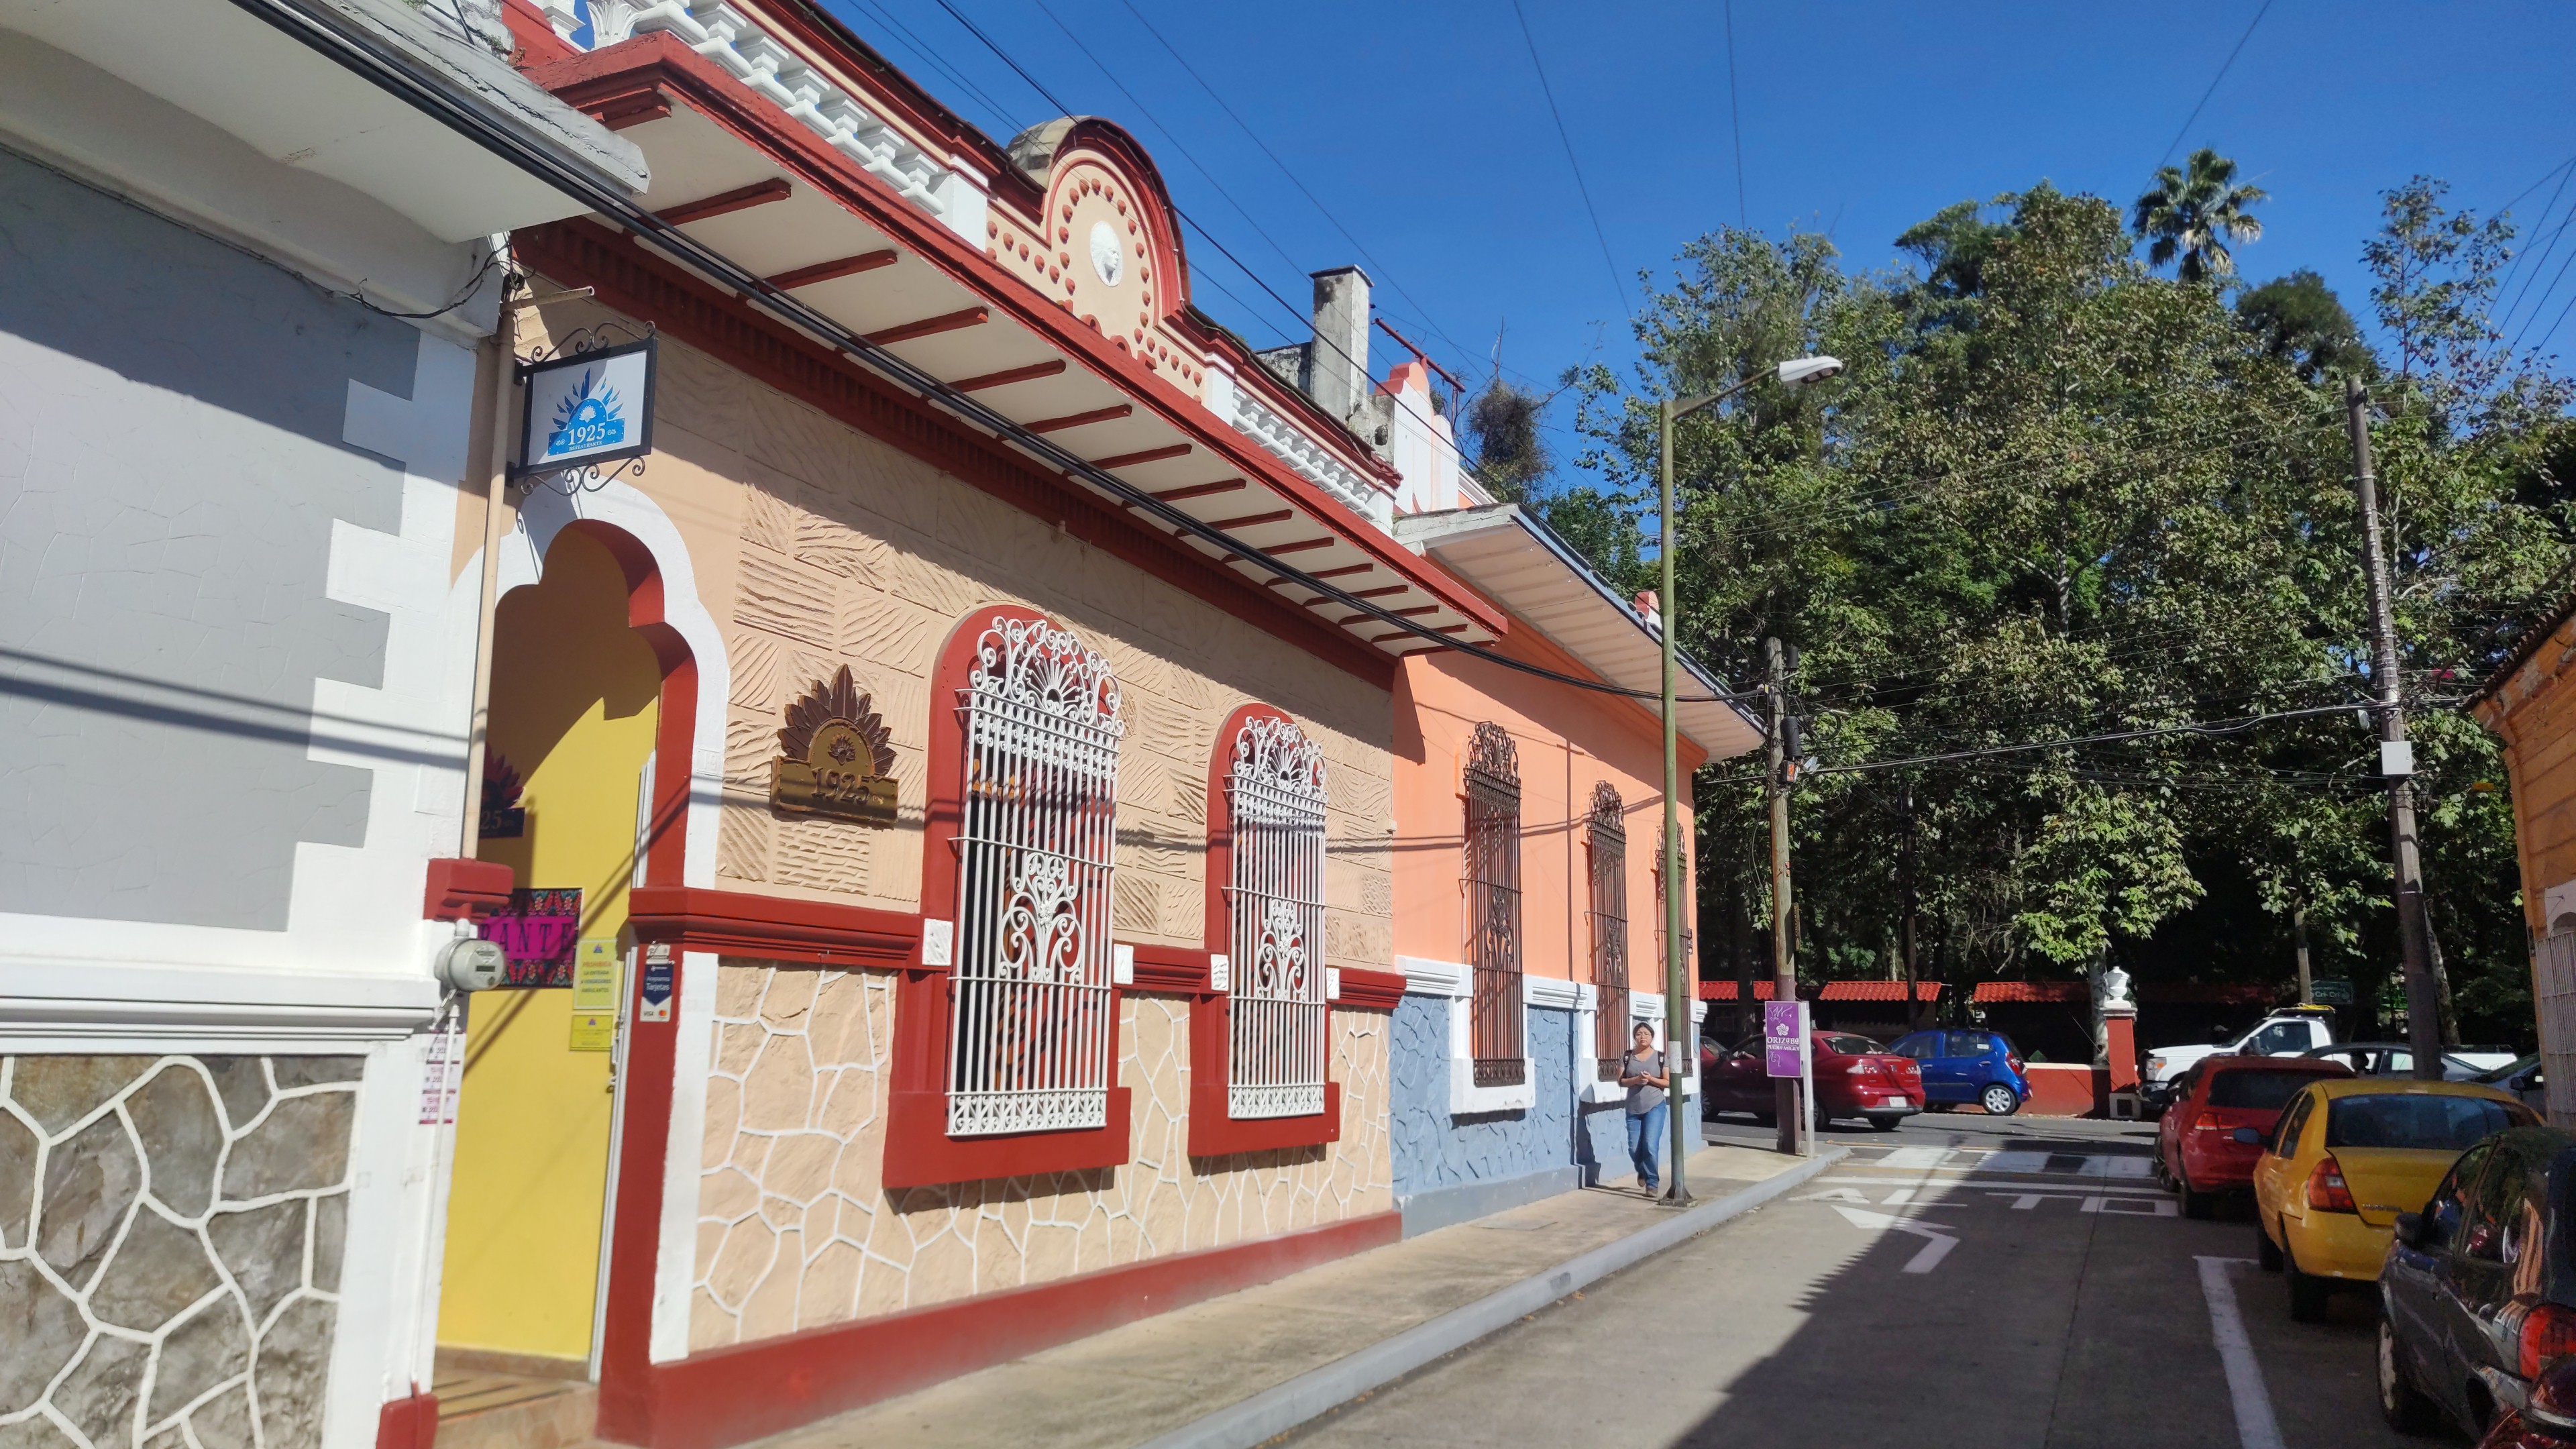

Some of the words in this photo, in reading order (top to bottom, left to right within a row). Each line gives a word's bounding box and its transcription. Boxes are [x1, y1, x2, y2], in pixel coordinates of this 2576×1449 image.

[568, 422, 606, 446] 1925
[568, 440, 602, 451] RESTAURANTE
[810, 766, 869, 806] 1925
[646, 982, 670, 992] Tarjetas
[1786, 1187, 2179, 1217] ALTO
